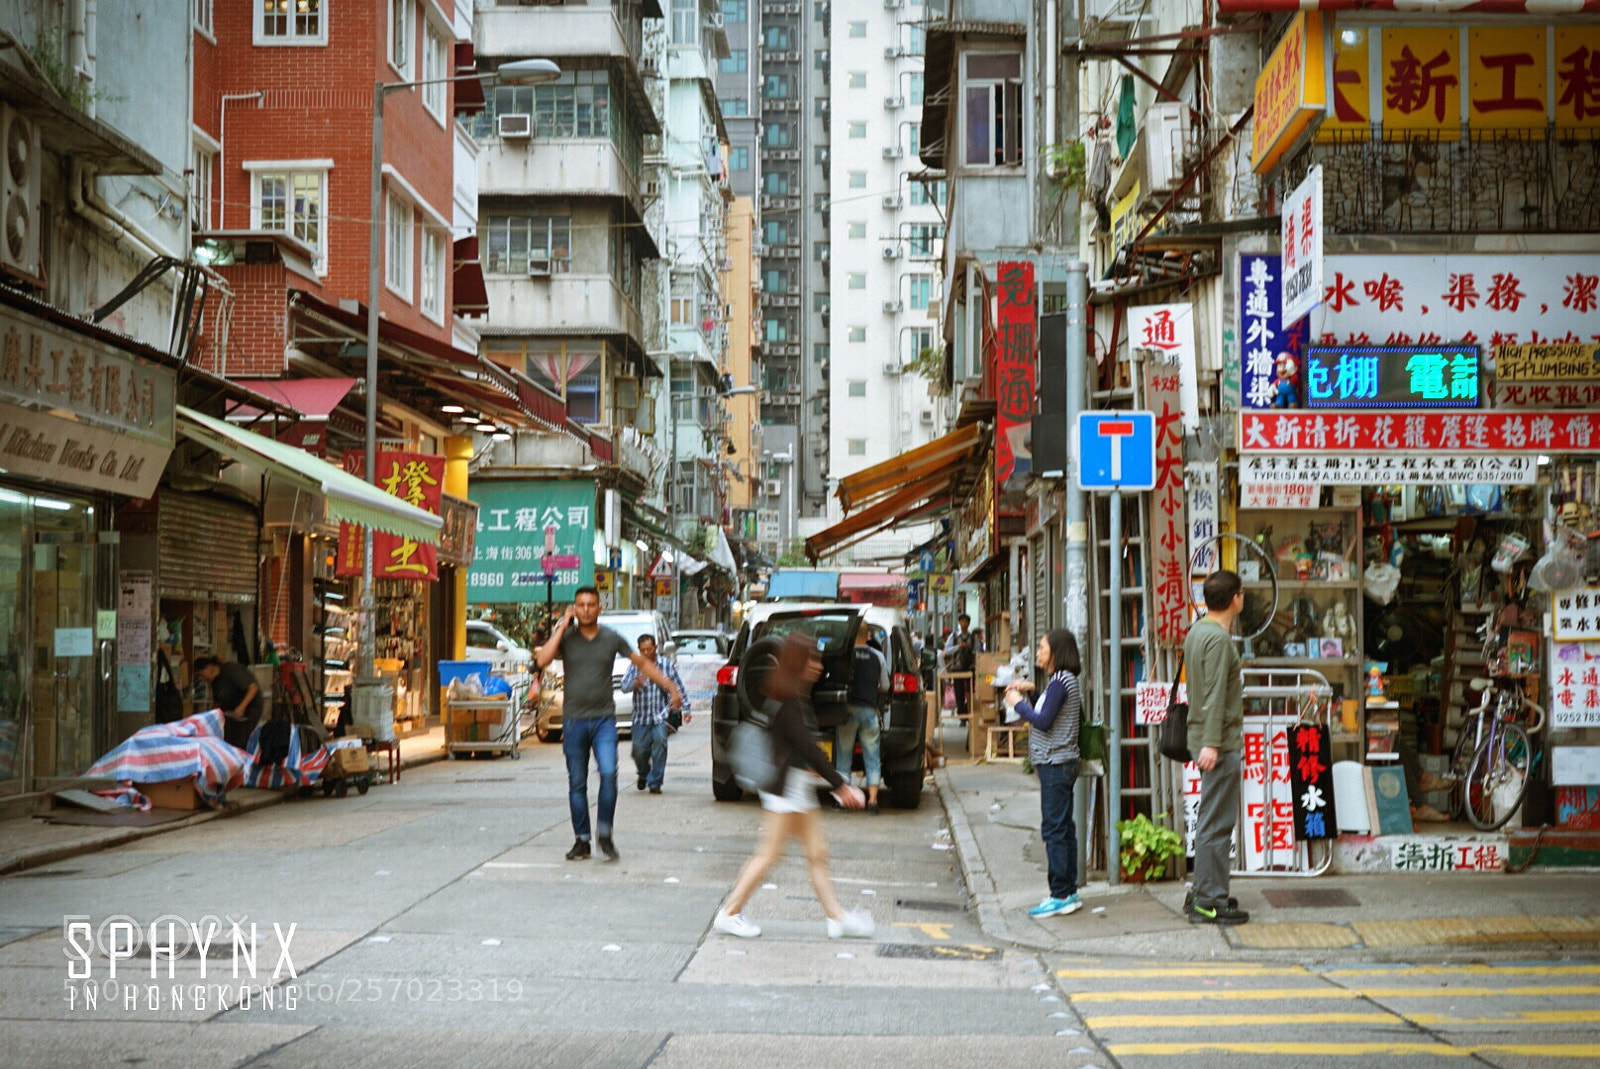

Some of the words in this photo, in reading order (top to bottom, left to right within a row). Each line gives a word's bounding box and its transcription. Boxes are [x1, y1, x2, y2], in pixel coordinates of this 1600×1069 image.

[1141, 309, 1182, 350] 通
[467, 571, 504, 587] 8960
[1556, 711, 1582, 724] 9252
[1394, 842, 1502, 870] 清拆工程
